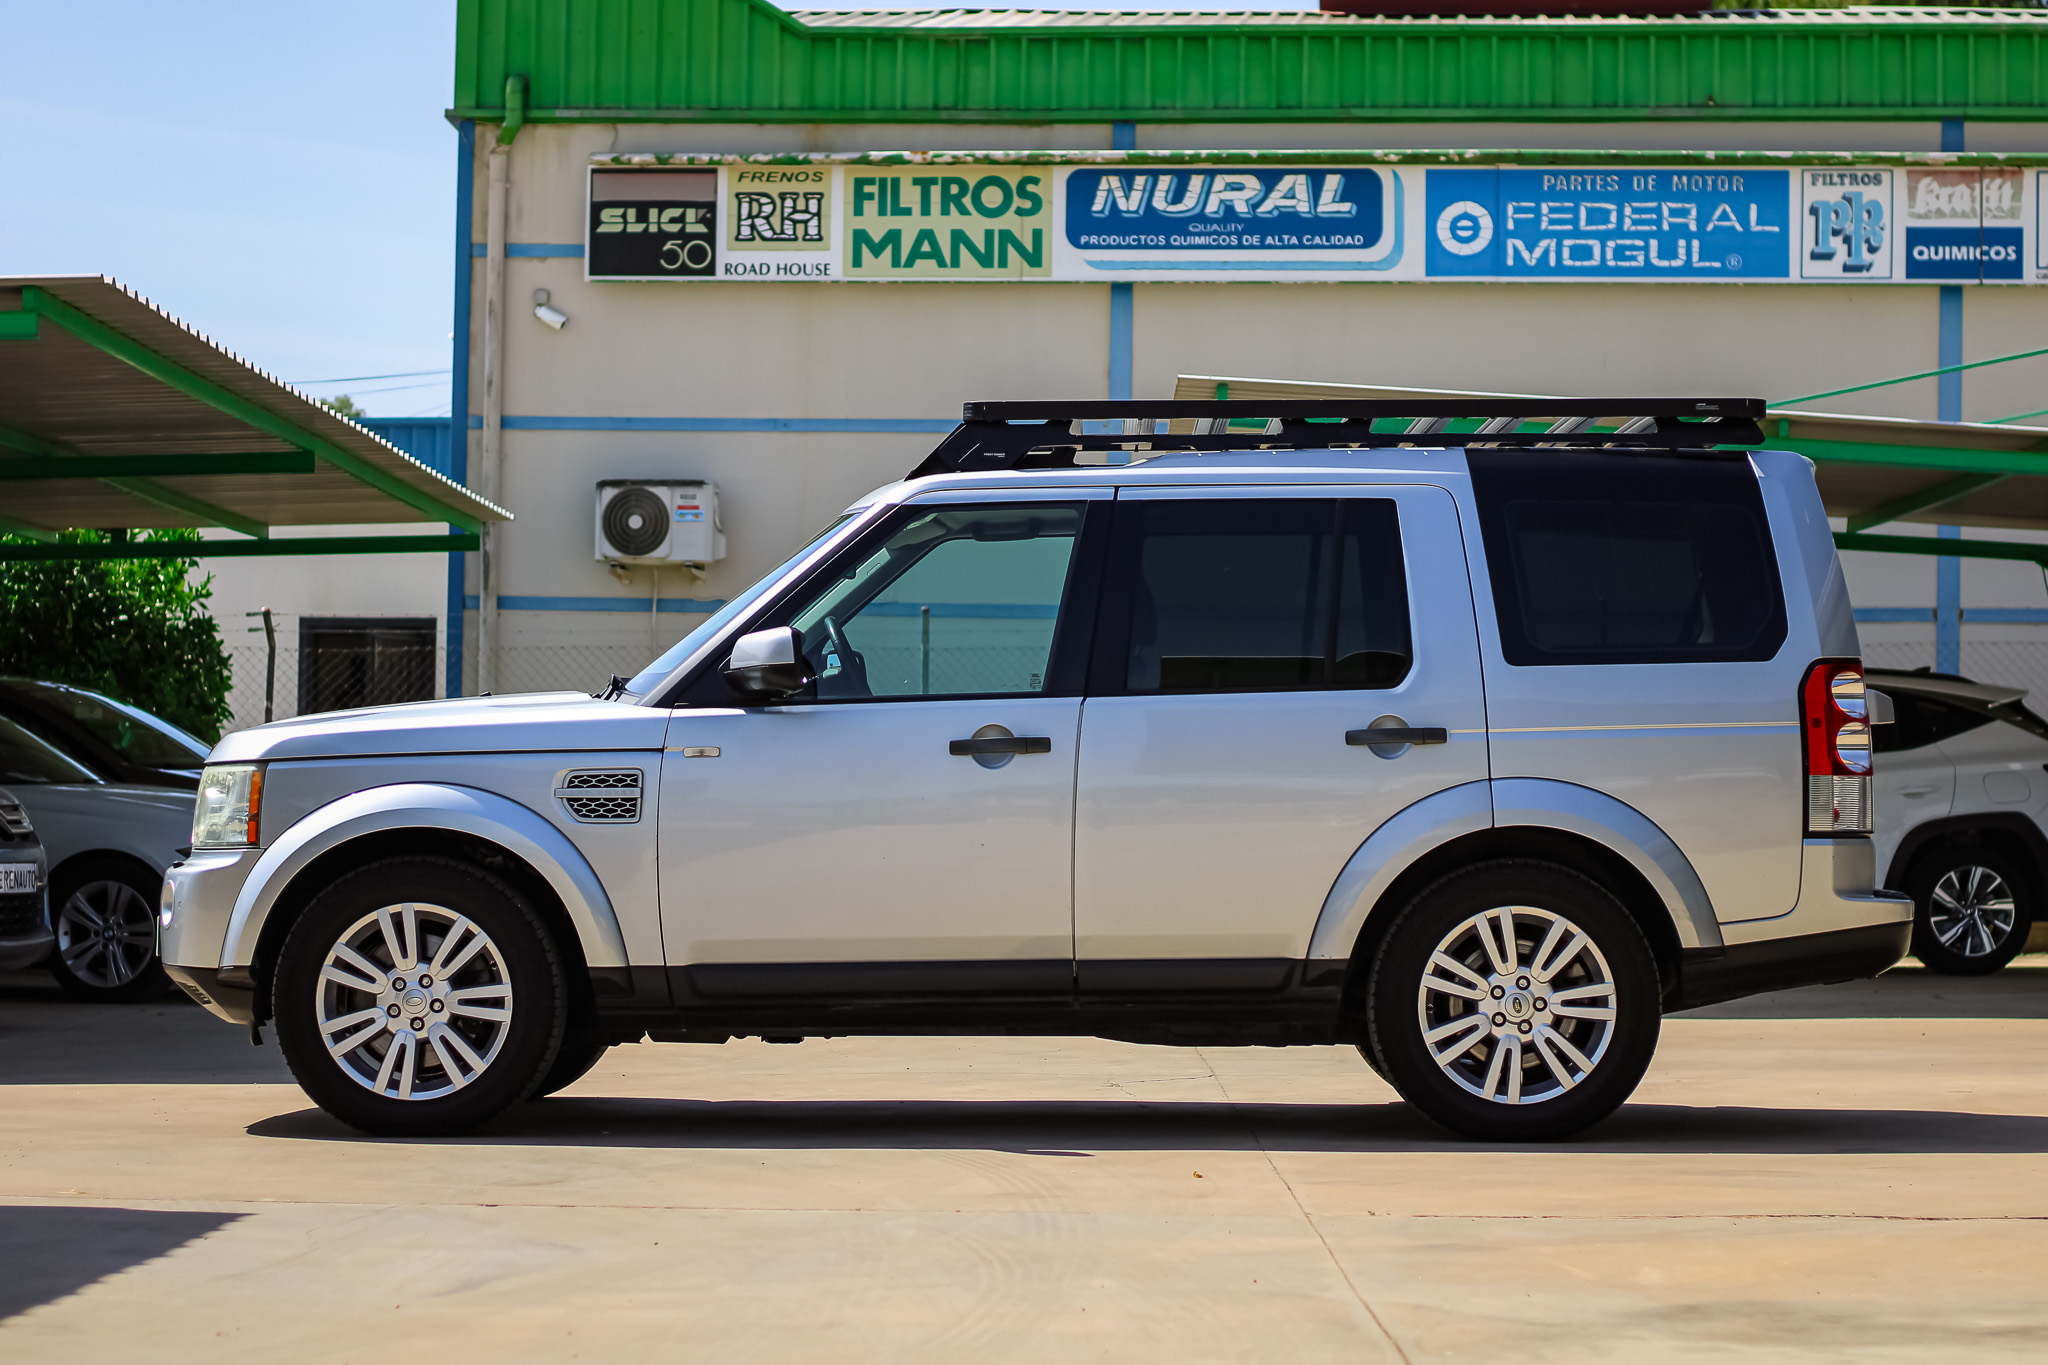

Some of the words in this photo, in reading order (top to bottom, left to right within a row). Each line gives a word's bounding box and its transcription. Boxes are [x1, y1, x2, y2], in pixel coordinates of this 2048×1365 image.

[737, 171, 825, 183] FRENOS
[1543, 175, 1619, 191] PARTES
[1633, 175, 1657, 191] DE
[1672, 175, 1744, 192] MOTOR
[1811, 173, 1883, 187] FILTROS
[853, 175, 1043, 219] FILTROS
[1091, 173, 1358, 217] NURAL
[595, 207, 709, 233] SLICK
[735, 192, 824, 242] RH
[1188, 222, 1244, 232] QUALITY
[1506, 201, 1780, 232] FEDERAL
[852, 228, 1043, 268] MANN
[1081, 235, 1166, 245] PRODUCTOS
[1170, 235, 1238, 246] QUIMICOS
[1242, 235, 1261, 245] DE
[1265, 235, 1299, 245] ALTA
[1303, 235, 1364, 245] CALIDAD
[1506, 239, 1722, 267] MOGUL
[1912, 245, 2017, 261] QUIMICOS
[660, 240, 712, 269] 50
[724, 263, 771, 276] ROAD
[776, 263, 831, 276] HOUSE
